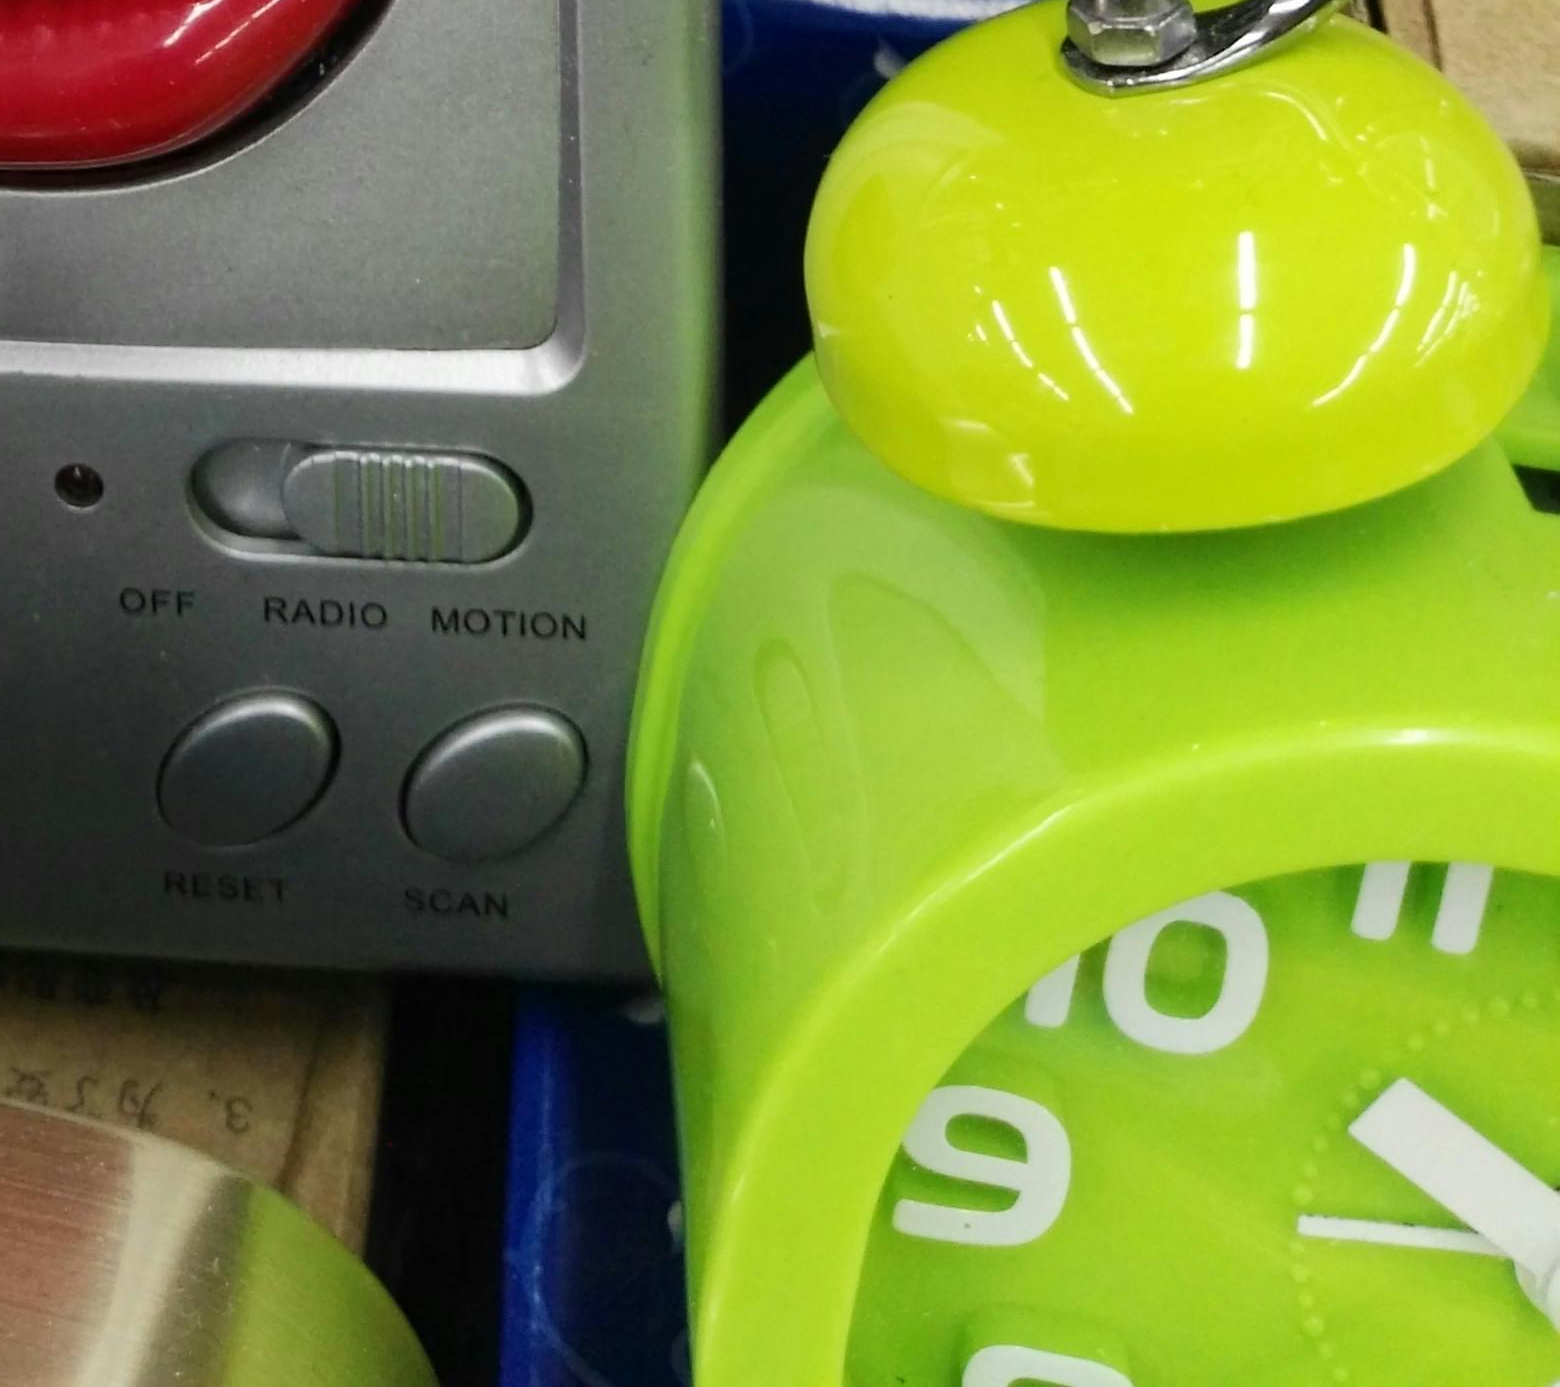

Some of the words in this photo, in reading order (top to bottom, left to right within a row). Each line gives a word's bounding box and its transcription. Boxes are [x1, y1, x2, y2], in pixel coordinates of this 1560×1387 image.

[118, 586, 196, 618] OFF
[262, 595, 389, 629] RADIO
[430, 606, 588, 642] MOTION
[162, 869, 288, 904] RESET
[403, 885, 510, 918] SCAN
[893, 1084, 1072, 1247] 9
